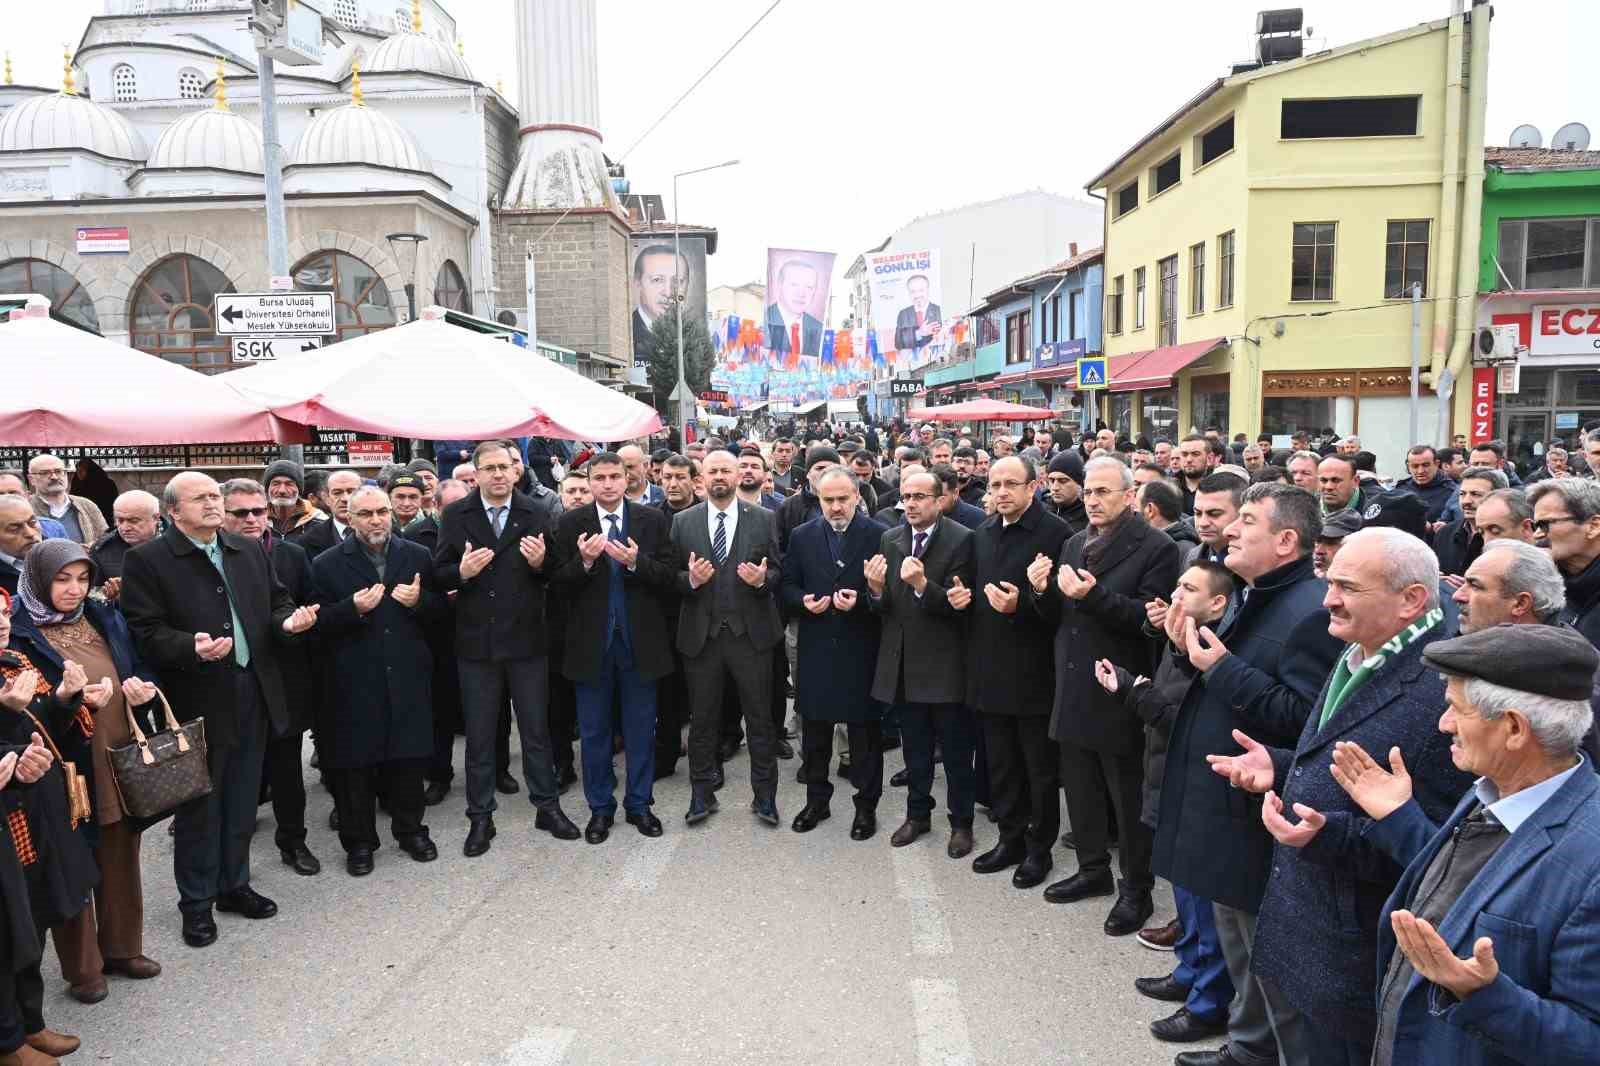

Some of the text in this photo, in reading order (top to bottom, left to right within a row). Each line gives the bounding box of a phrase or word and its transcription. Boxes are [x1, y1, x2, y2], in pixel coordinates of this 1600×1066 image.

[259, 297, 314, 308] Bursa Uludağ
[245, 309, 330, 319] Üniversitesi Orhaneli
[247, 321, 330, 331] Meslek Yüksekokulu
[237, 341, 275, 358] SGK
[319, 433, 357, 442] YASAKTIR
